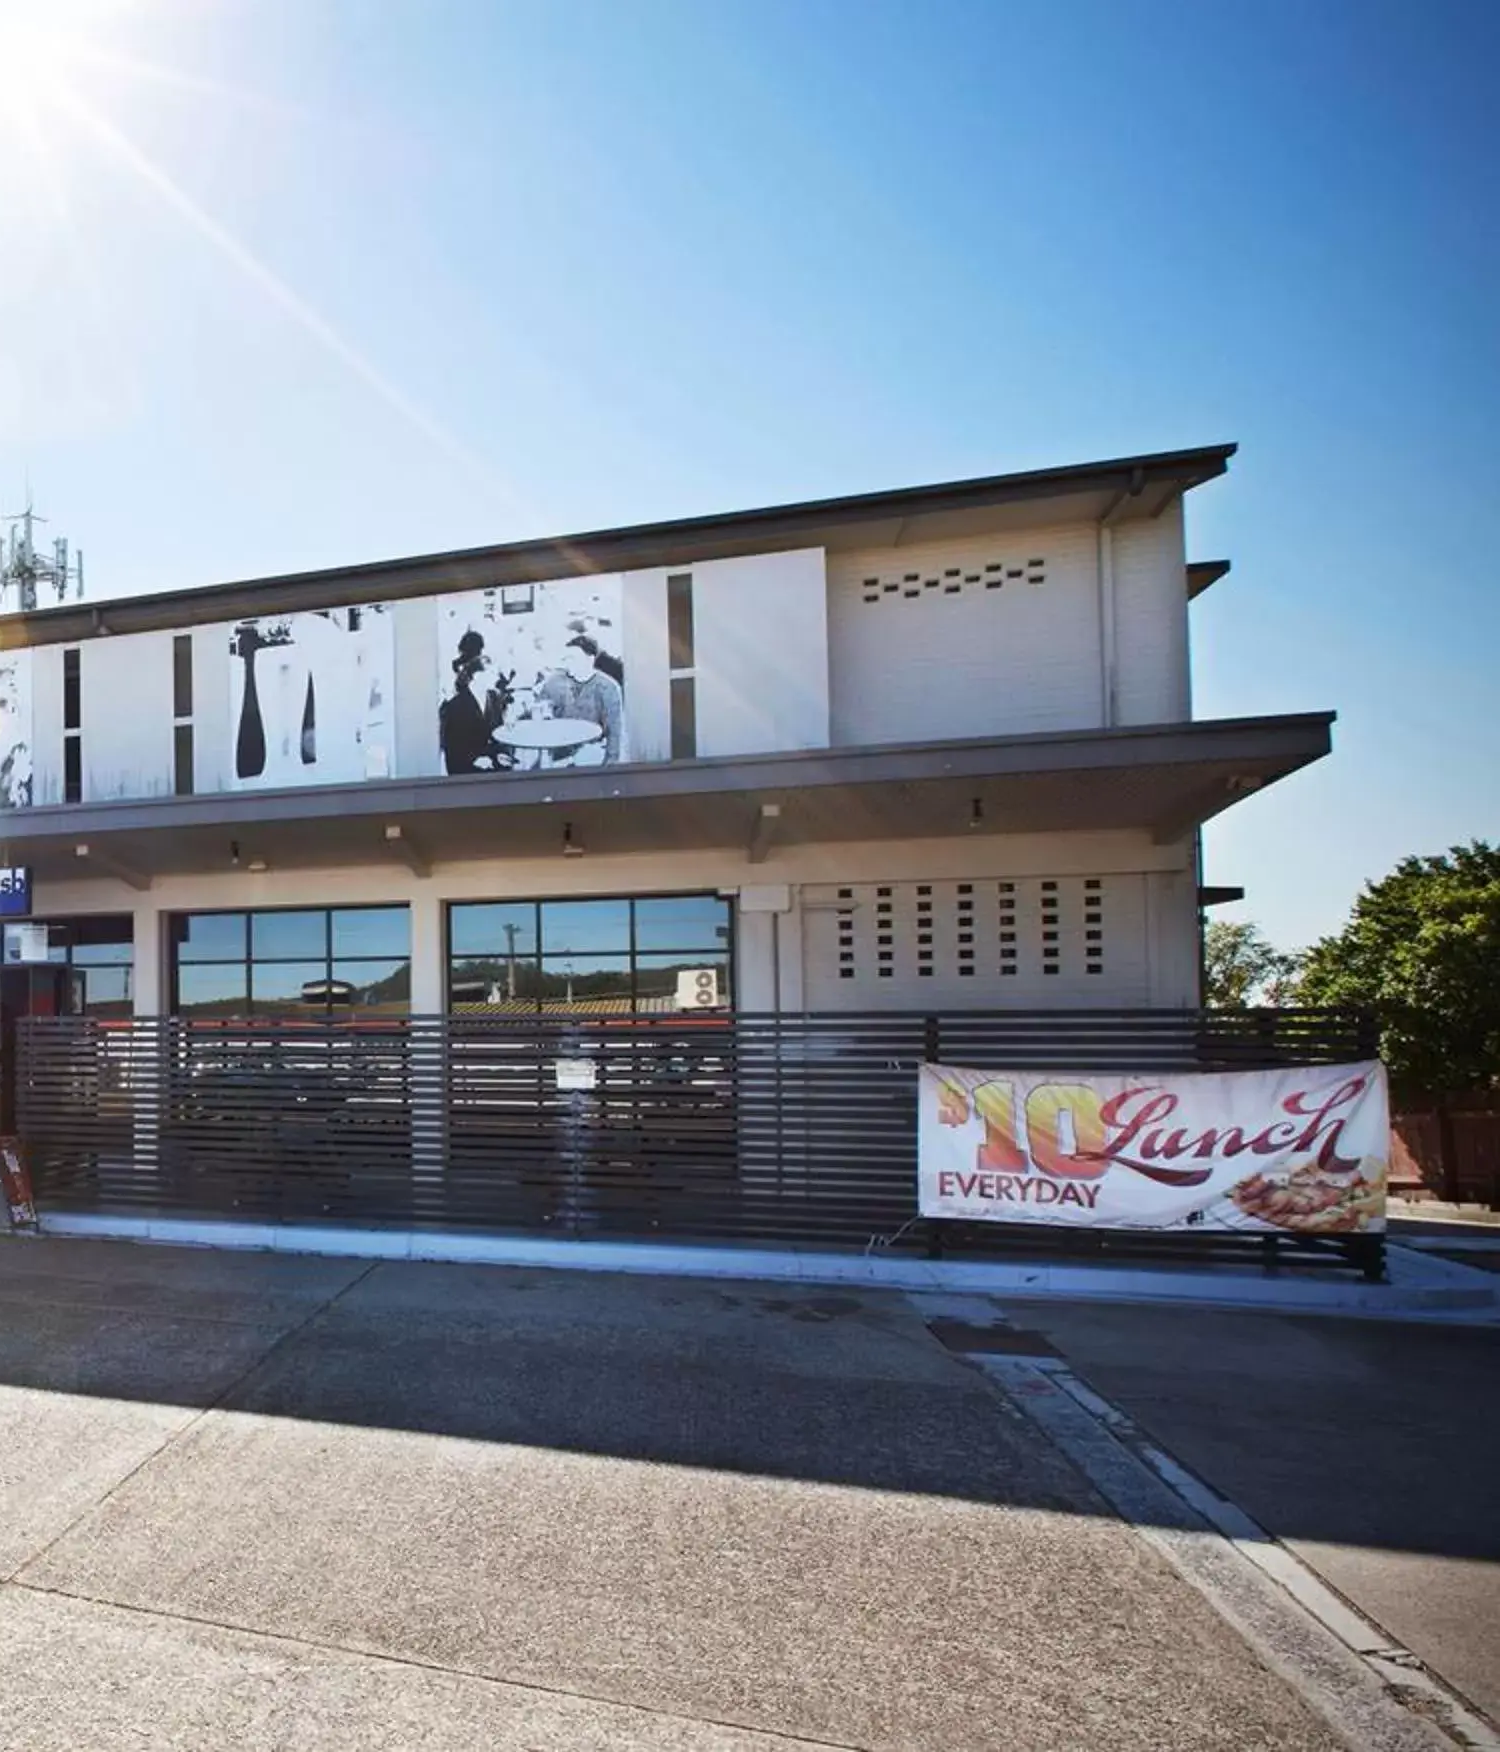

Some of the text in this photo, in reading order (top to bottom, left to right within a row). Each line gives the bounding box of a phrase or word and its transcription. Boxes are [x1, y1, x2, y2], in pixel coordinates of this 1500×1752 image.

[938, 1076, 1366, 1187] $10 Lunch
[938, 1171, 1102, 1209] EVERYDAY
